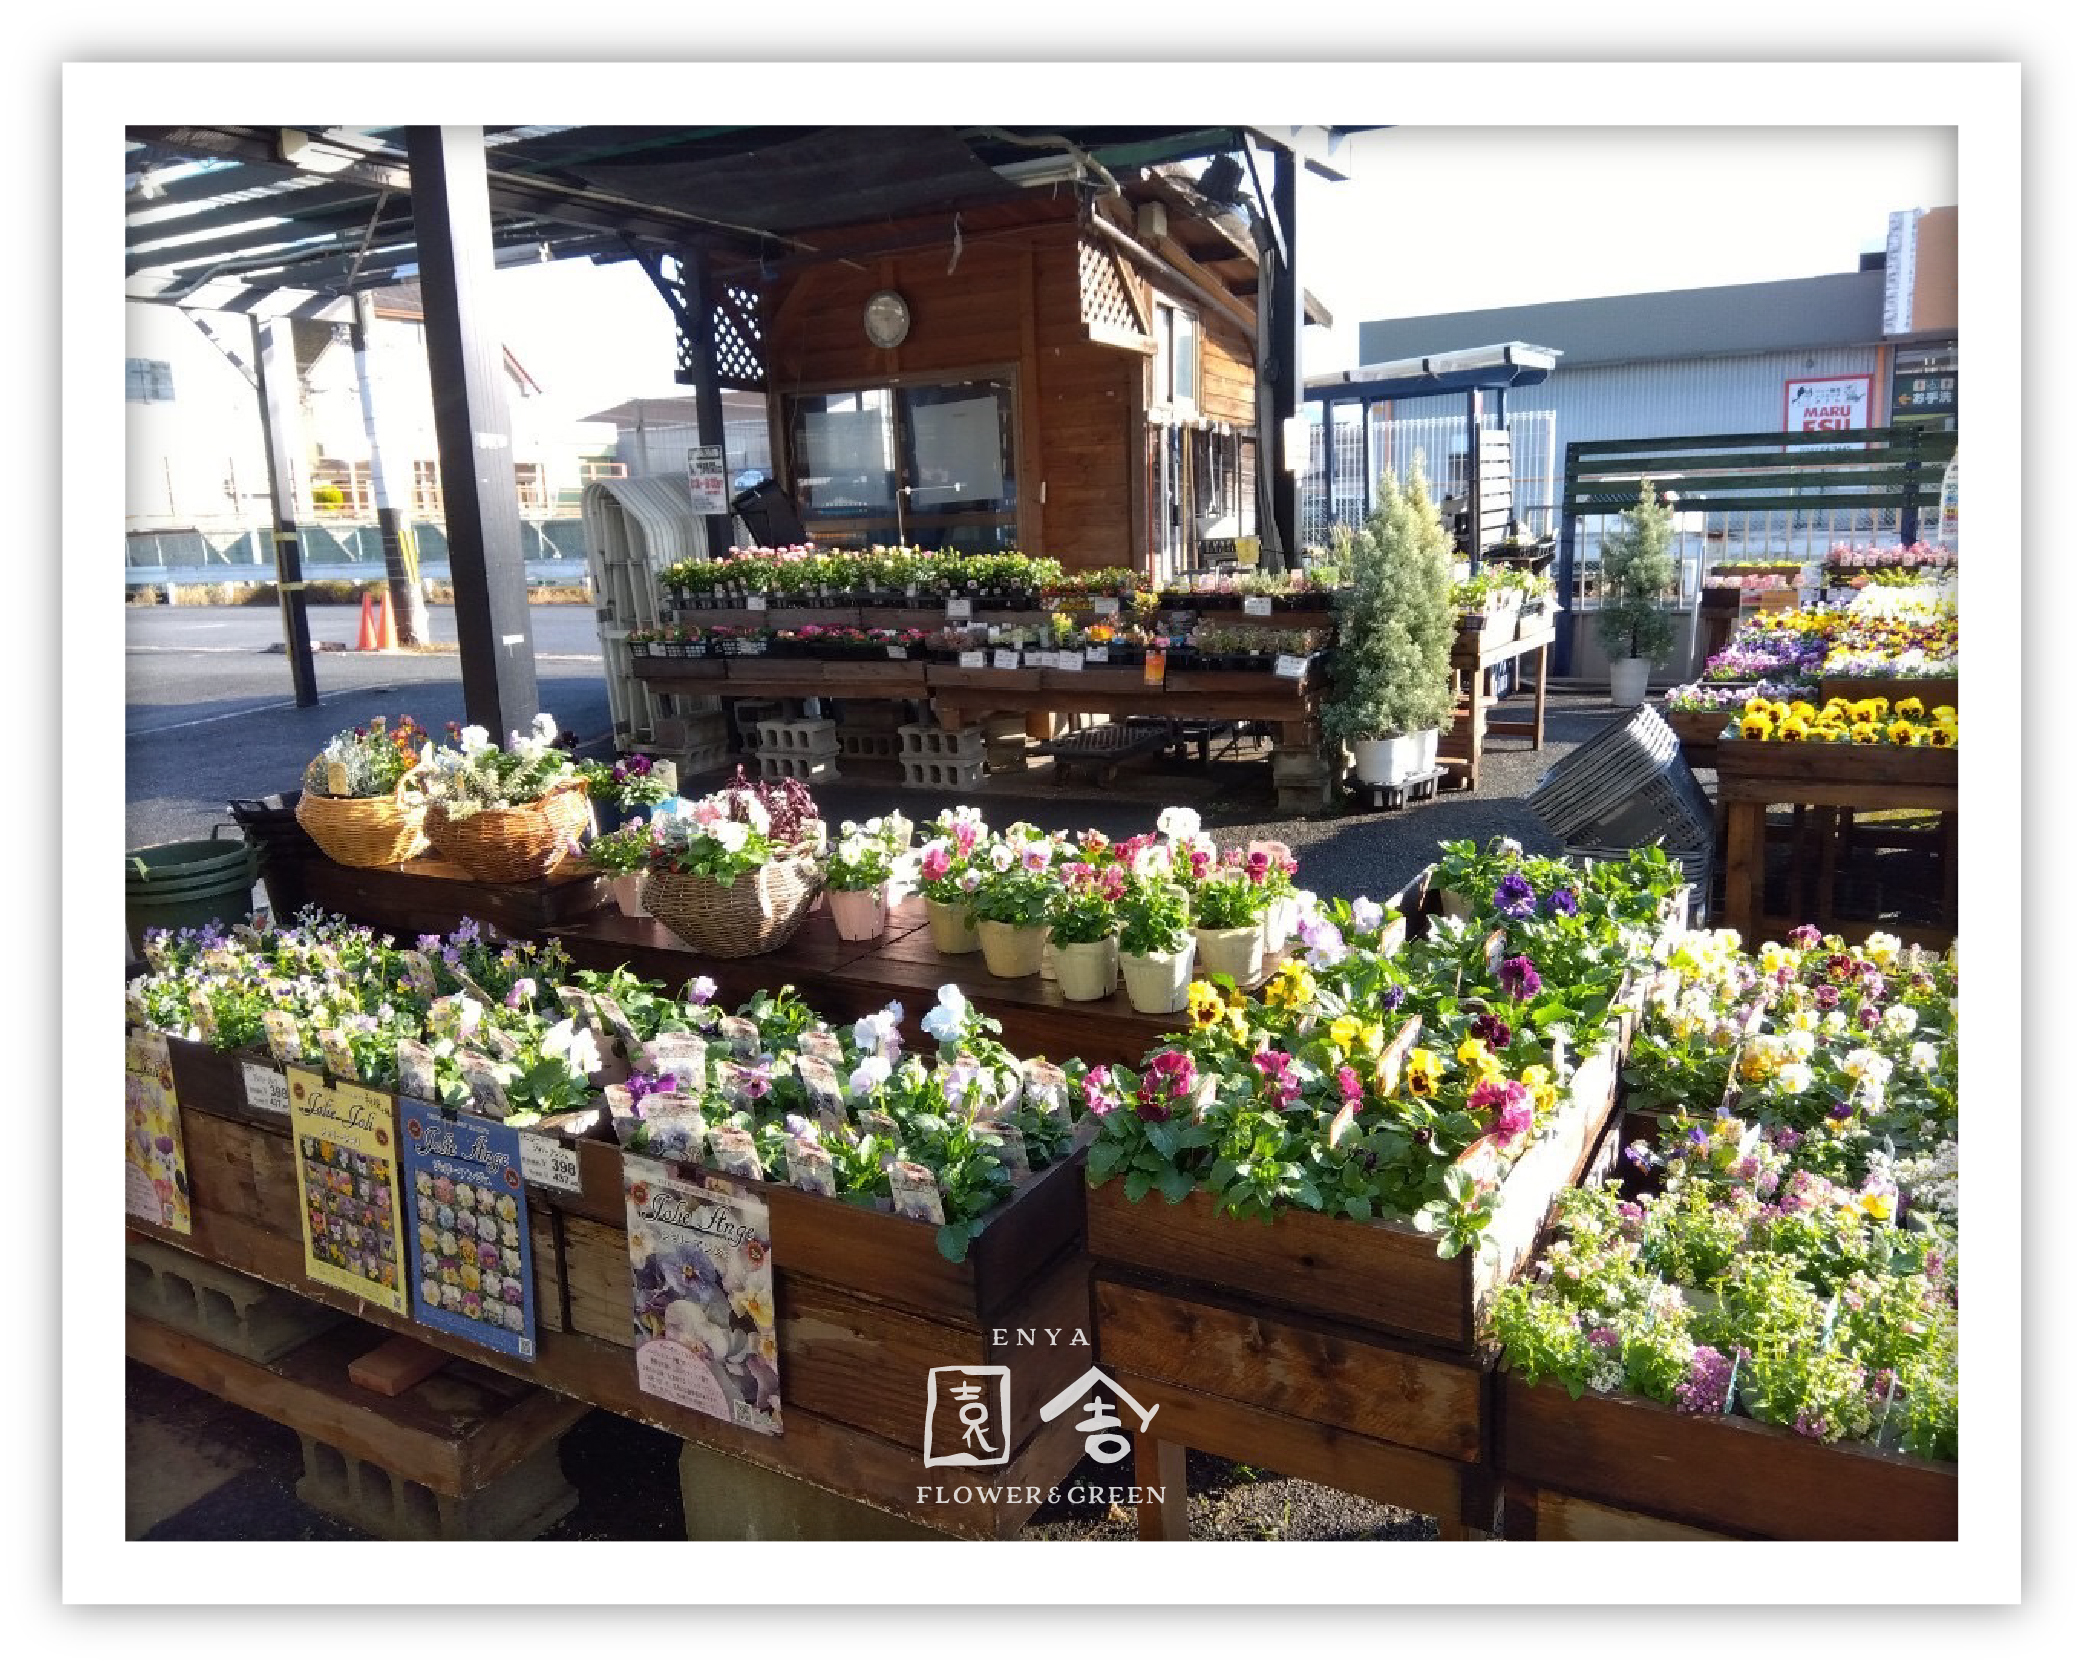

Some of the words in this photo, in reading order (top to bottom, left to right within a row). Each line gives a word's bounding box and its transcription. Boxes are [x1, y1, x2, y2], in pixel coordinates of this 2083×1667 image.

[1803, 405, 1851, 418] MARU
[414, 1126, 458, 1156] Jolie
[461, 1135, 510, 1174] Ange
[551, 1159, 577, 1176] 398
[639, 1193, 692, 1226] Jolie
[699, 1204, 756, 1248] Ange
